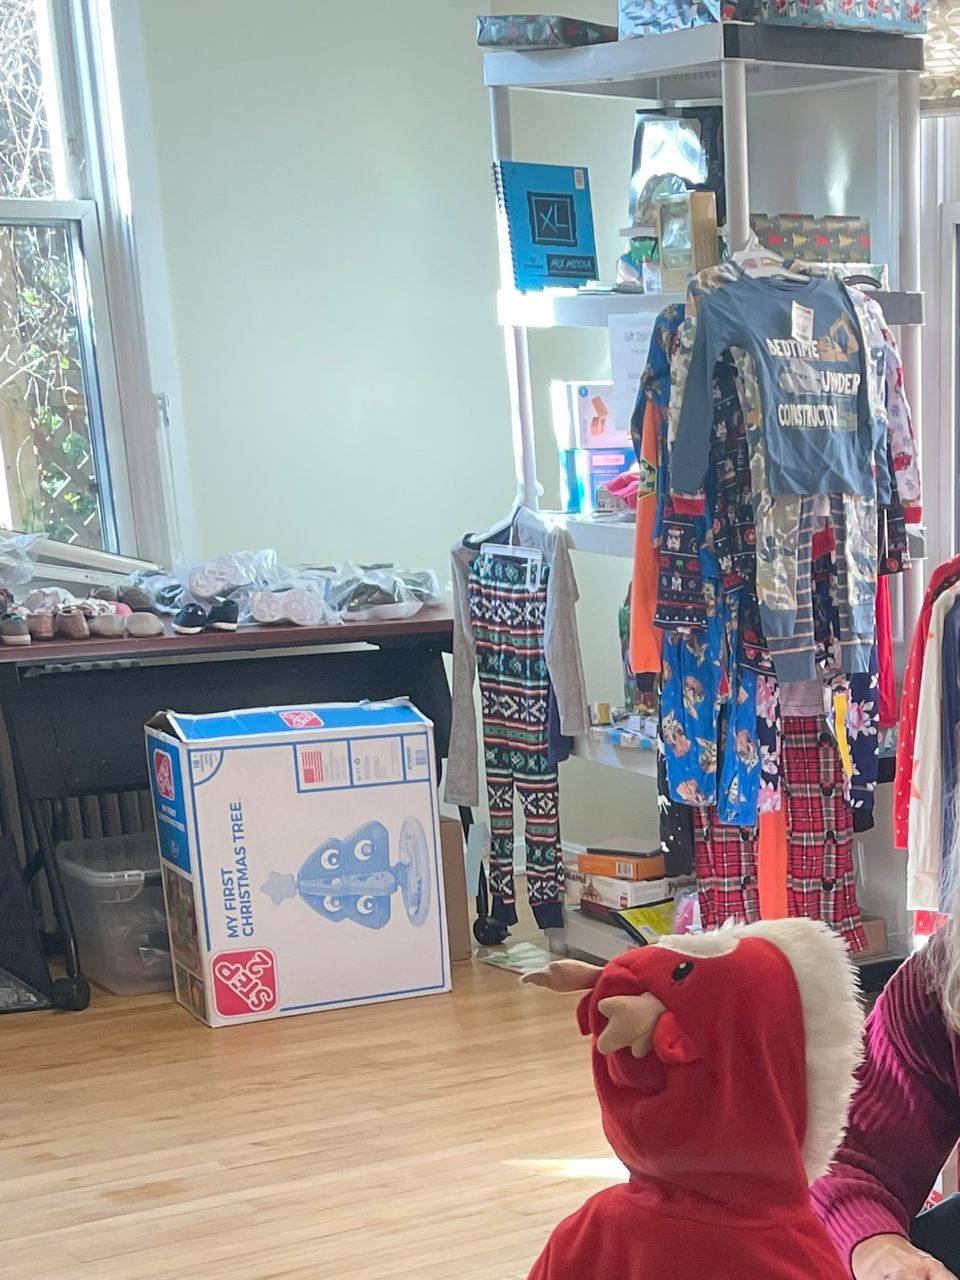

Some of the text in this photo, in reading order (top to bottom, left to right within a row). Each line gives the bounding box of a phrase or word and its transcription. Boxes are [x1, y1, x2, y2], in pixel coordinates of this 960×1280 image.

[539, 202, 569, 233] XL
[550, 256, 592, 270] MIX MEDIA
[766, 338, 820, 359] BEDTIME
[820, 370, 861, 396] UNDER
[229, 801, 255, 937] CHRISTMAS TREE
[220, 867, 240, 938] MY FIRST
